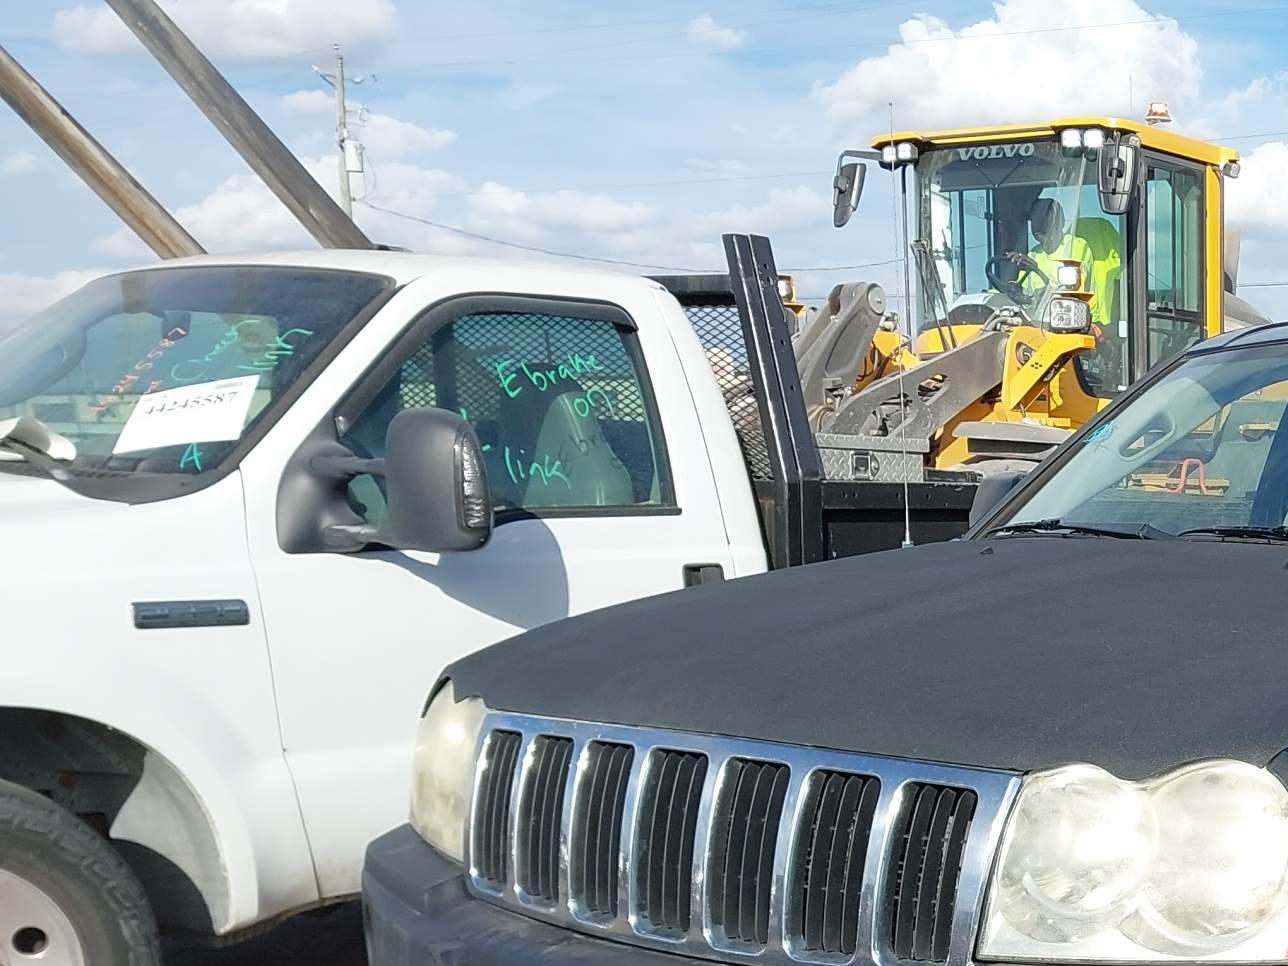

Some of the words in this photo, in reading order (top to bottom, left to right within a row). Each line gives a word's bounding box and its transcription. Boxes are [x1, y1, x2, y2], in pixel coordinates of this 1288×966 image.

[958, 143, 1035, 160] VOLVO
[144, 391, 238, 415] 44245587
[180, 442, 203, 472] A
[504, 446, 572, 489] link
